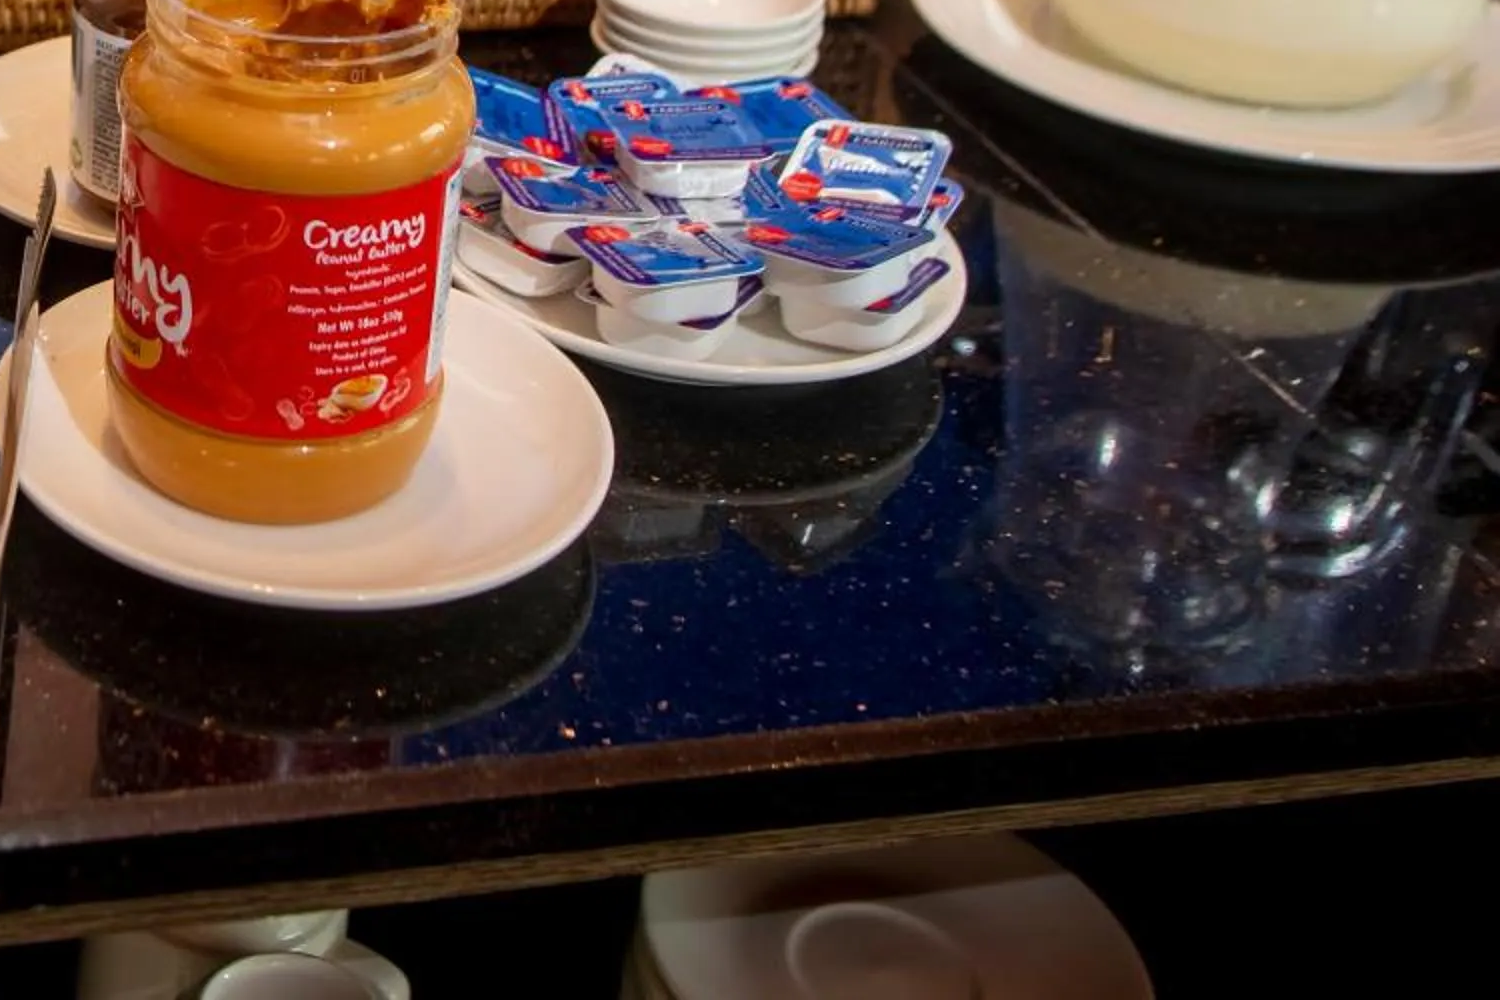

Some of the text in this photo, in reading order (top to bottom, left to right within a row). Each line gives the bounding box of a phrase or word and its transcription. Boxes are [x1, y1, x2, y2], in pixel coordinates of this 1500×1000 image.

[303, 211, 426, 249] Creamy
[316, 247, 364, 265] Peanut
[317, 321, 337, 334] Net
[339, 319, 354, 333] Wt
